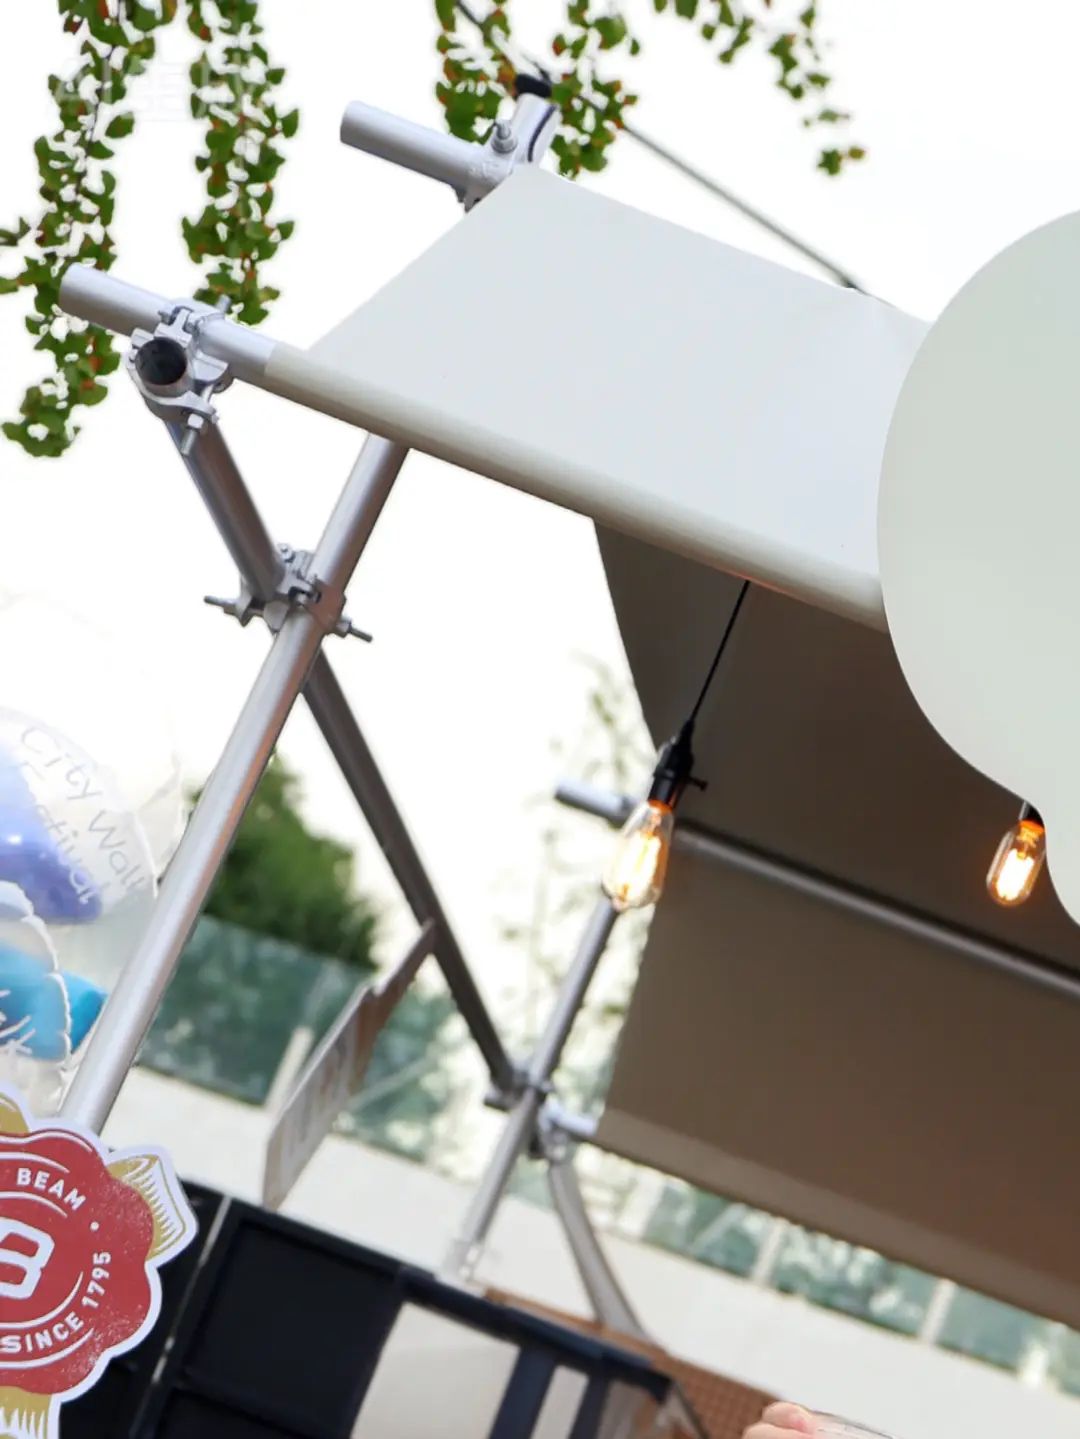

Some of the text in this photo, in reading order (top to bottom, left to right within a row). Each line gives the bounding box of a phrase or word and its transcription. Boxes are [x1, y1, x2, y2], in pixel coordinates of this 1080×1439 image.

[16, 1167, 86, 1210] BEAM
[0, 1251, 112, 1354] SINCE 1795
